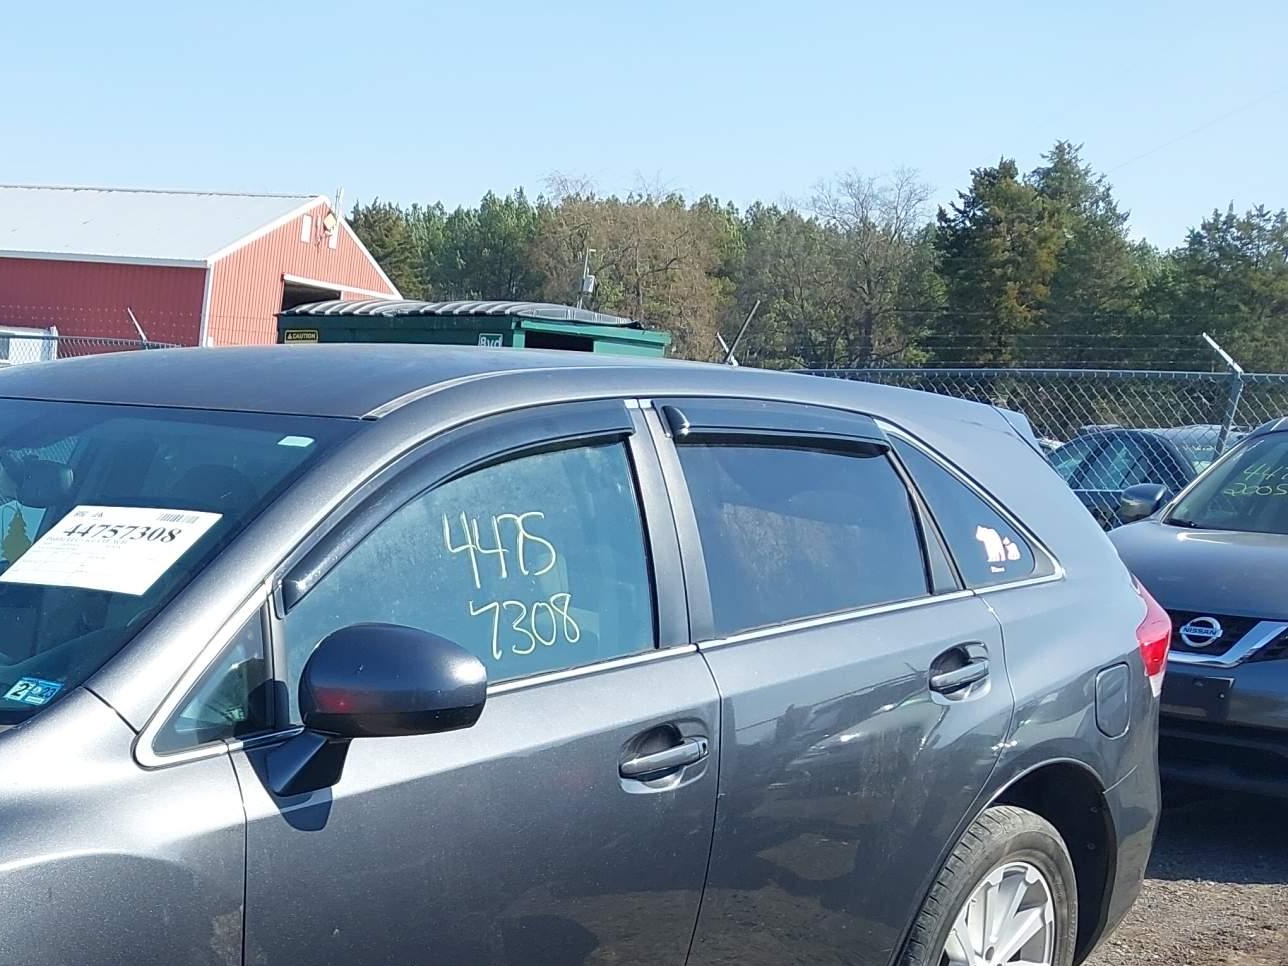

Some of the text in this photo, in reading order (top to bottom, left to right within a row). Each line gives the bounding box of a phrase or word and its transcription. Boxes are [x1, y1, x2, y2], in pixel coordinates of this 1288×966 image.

[63, 523, 182, 544] 44757308
[441, 510, 557, 590] 4475
[469, 592, 581, 661] 7308
[1184, 627, 1217, 636] NISSAN
[10, 682, 30, 697] 2
